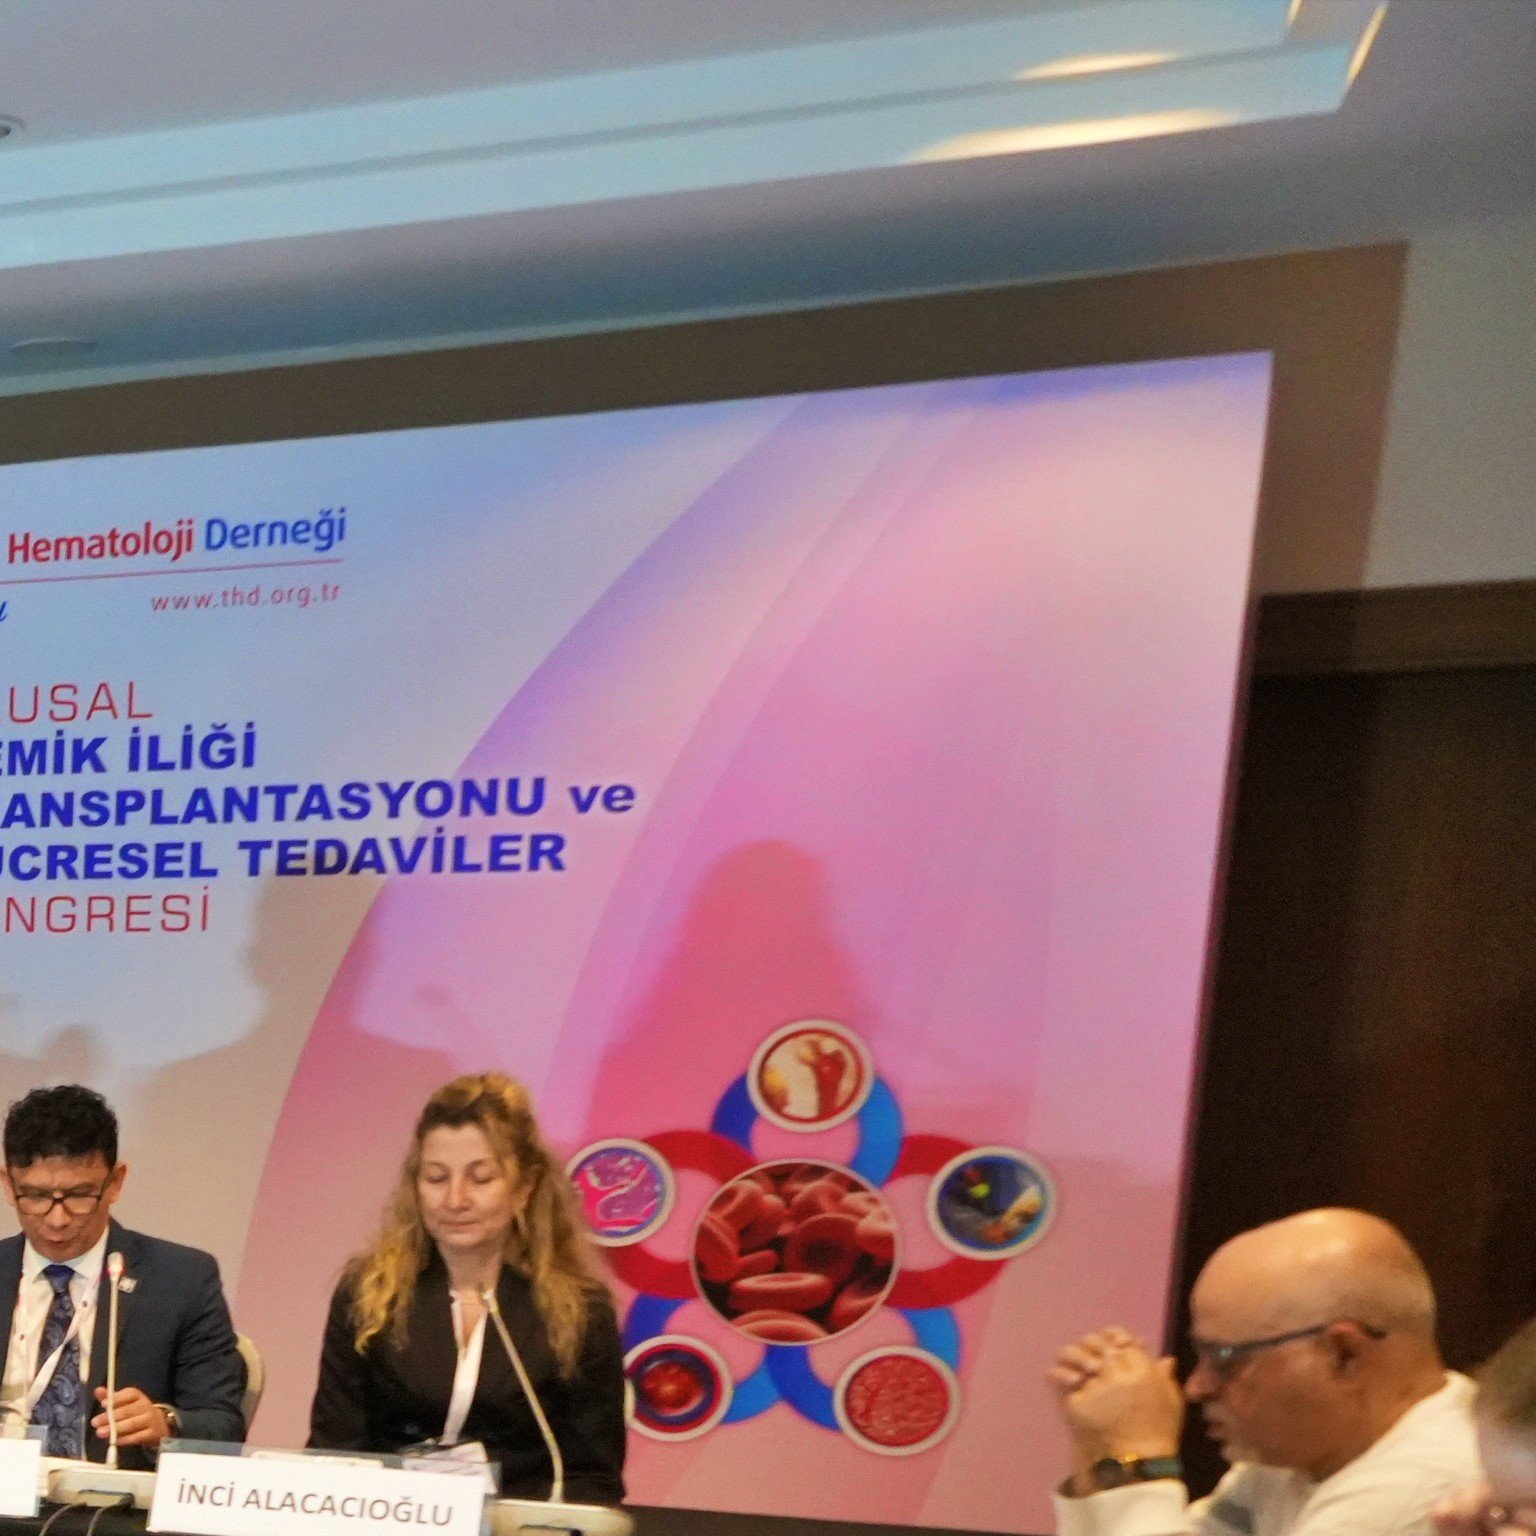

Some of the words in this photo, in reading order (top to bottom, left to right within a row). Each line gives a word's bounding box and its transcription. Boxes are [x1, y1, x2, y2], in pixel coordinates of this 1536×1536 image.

[7, 518, 195, 565] Hematoloji
[204, 507, 347, 552] Derneği
[151, 582, 341, 612] www.thd.org.tr
[127, 721, 256, 774] İLİĞİ
[567, 783, 637, 814] ve
[238, 826, 567, 878] TEDAVİLER
[176, 1477, 235, 1508] İNCİ
[242, 1487, 454, 1527] ALACACIOĞLU
